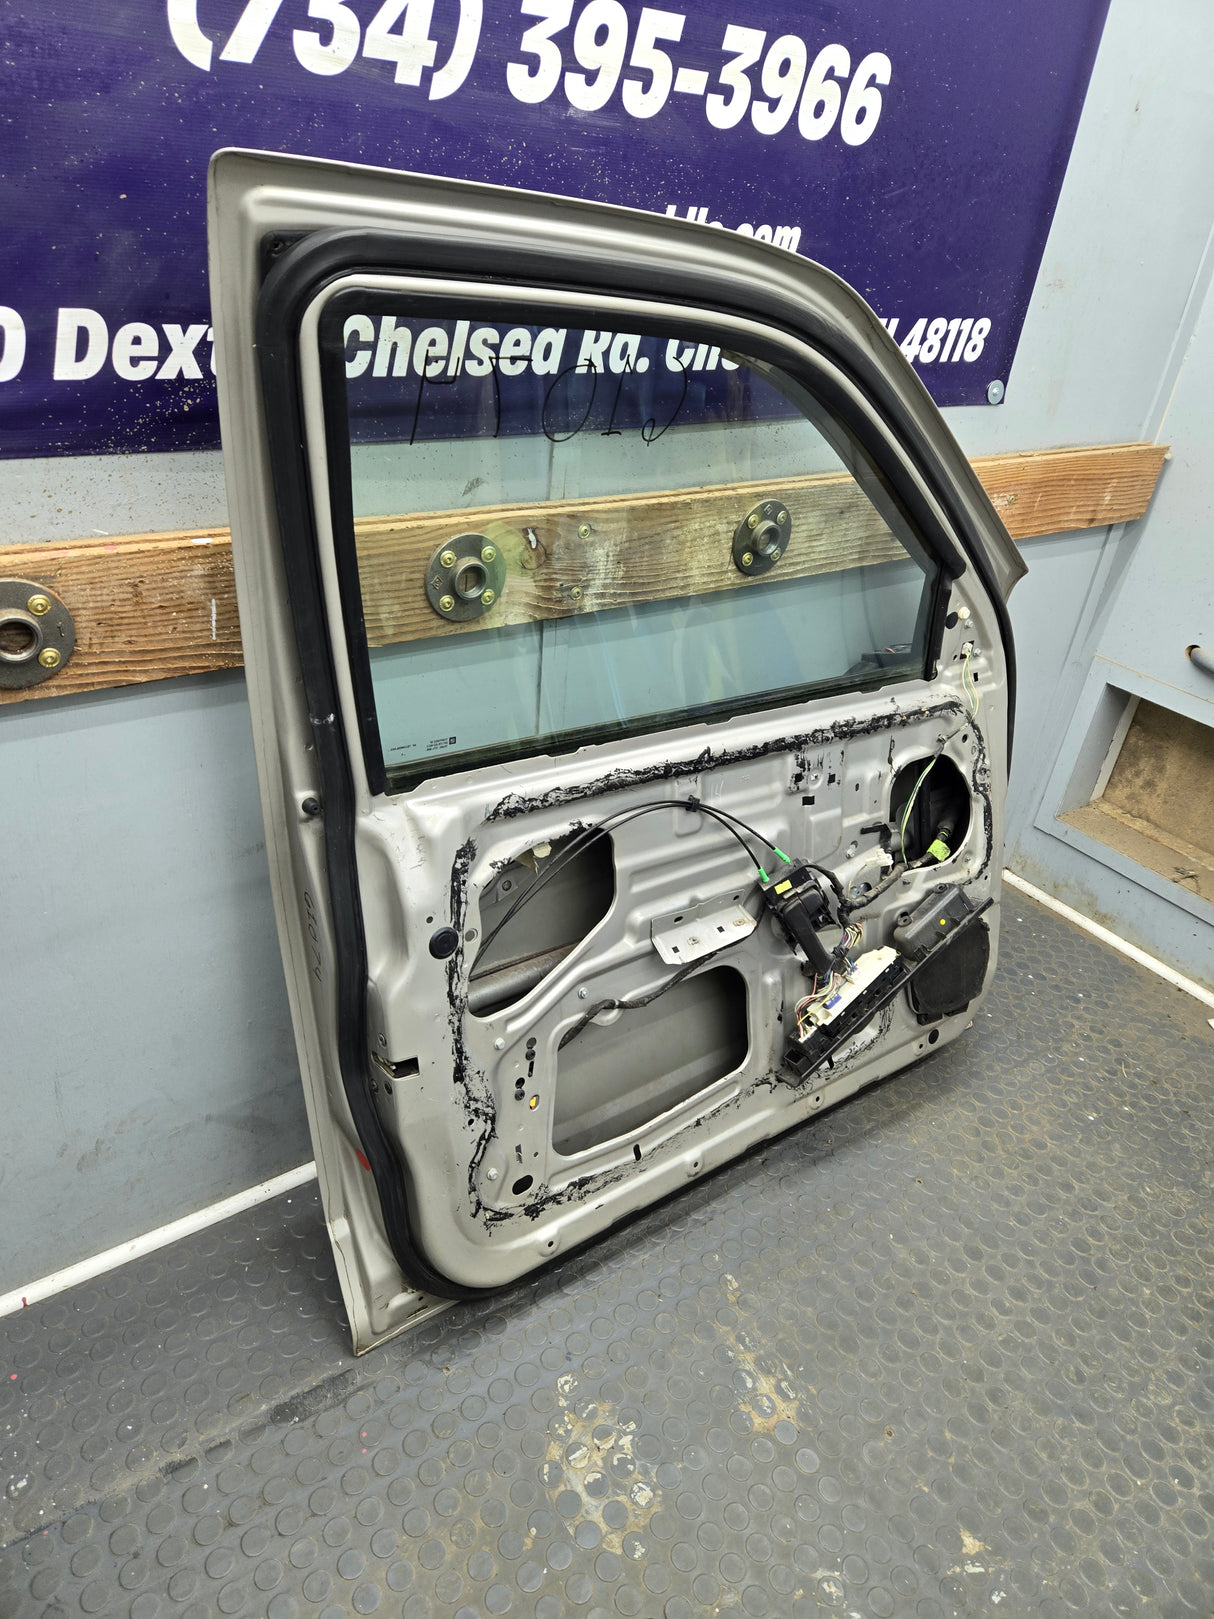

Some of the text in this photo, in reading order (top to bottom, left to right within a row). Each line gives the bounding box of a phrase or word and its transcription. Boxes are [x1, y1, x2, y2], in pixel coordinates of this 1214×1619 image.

[506, 0, 892, 146] 395-3966
[343, 314, 567, 379] Chelsea
[900, 317, 992, 363] 48118
